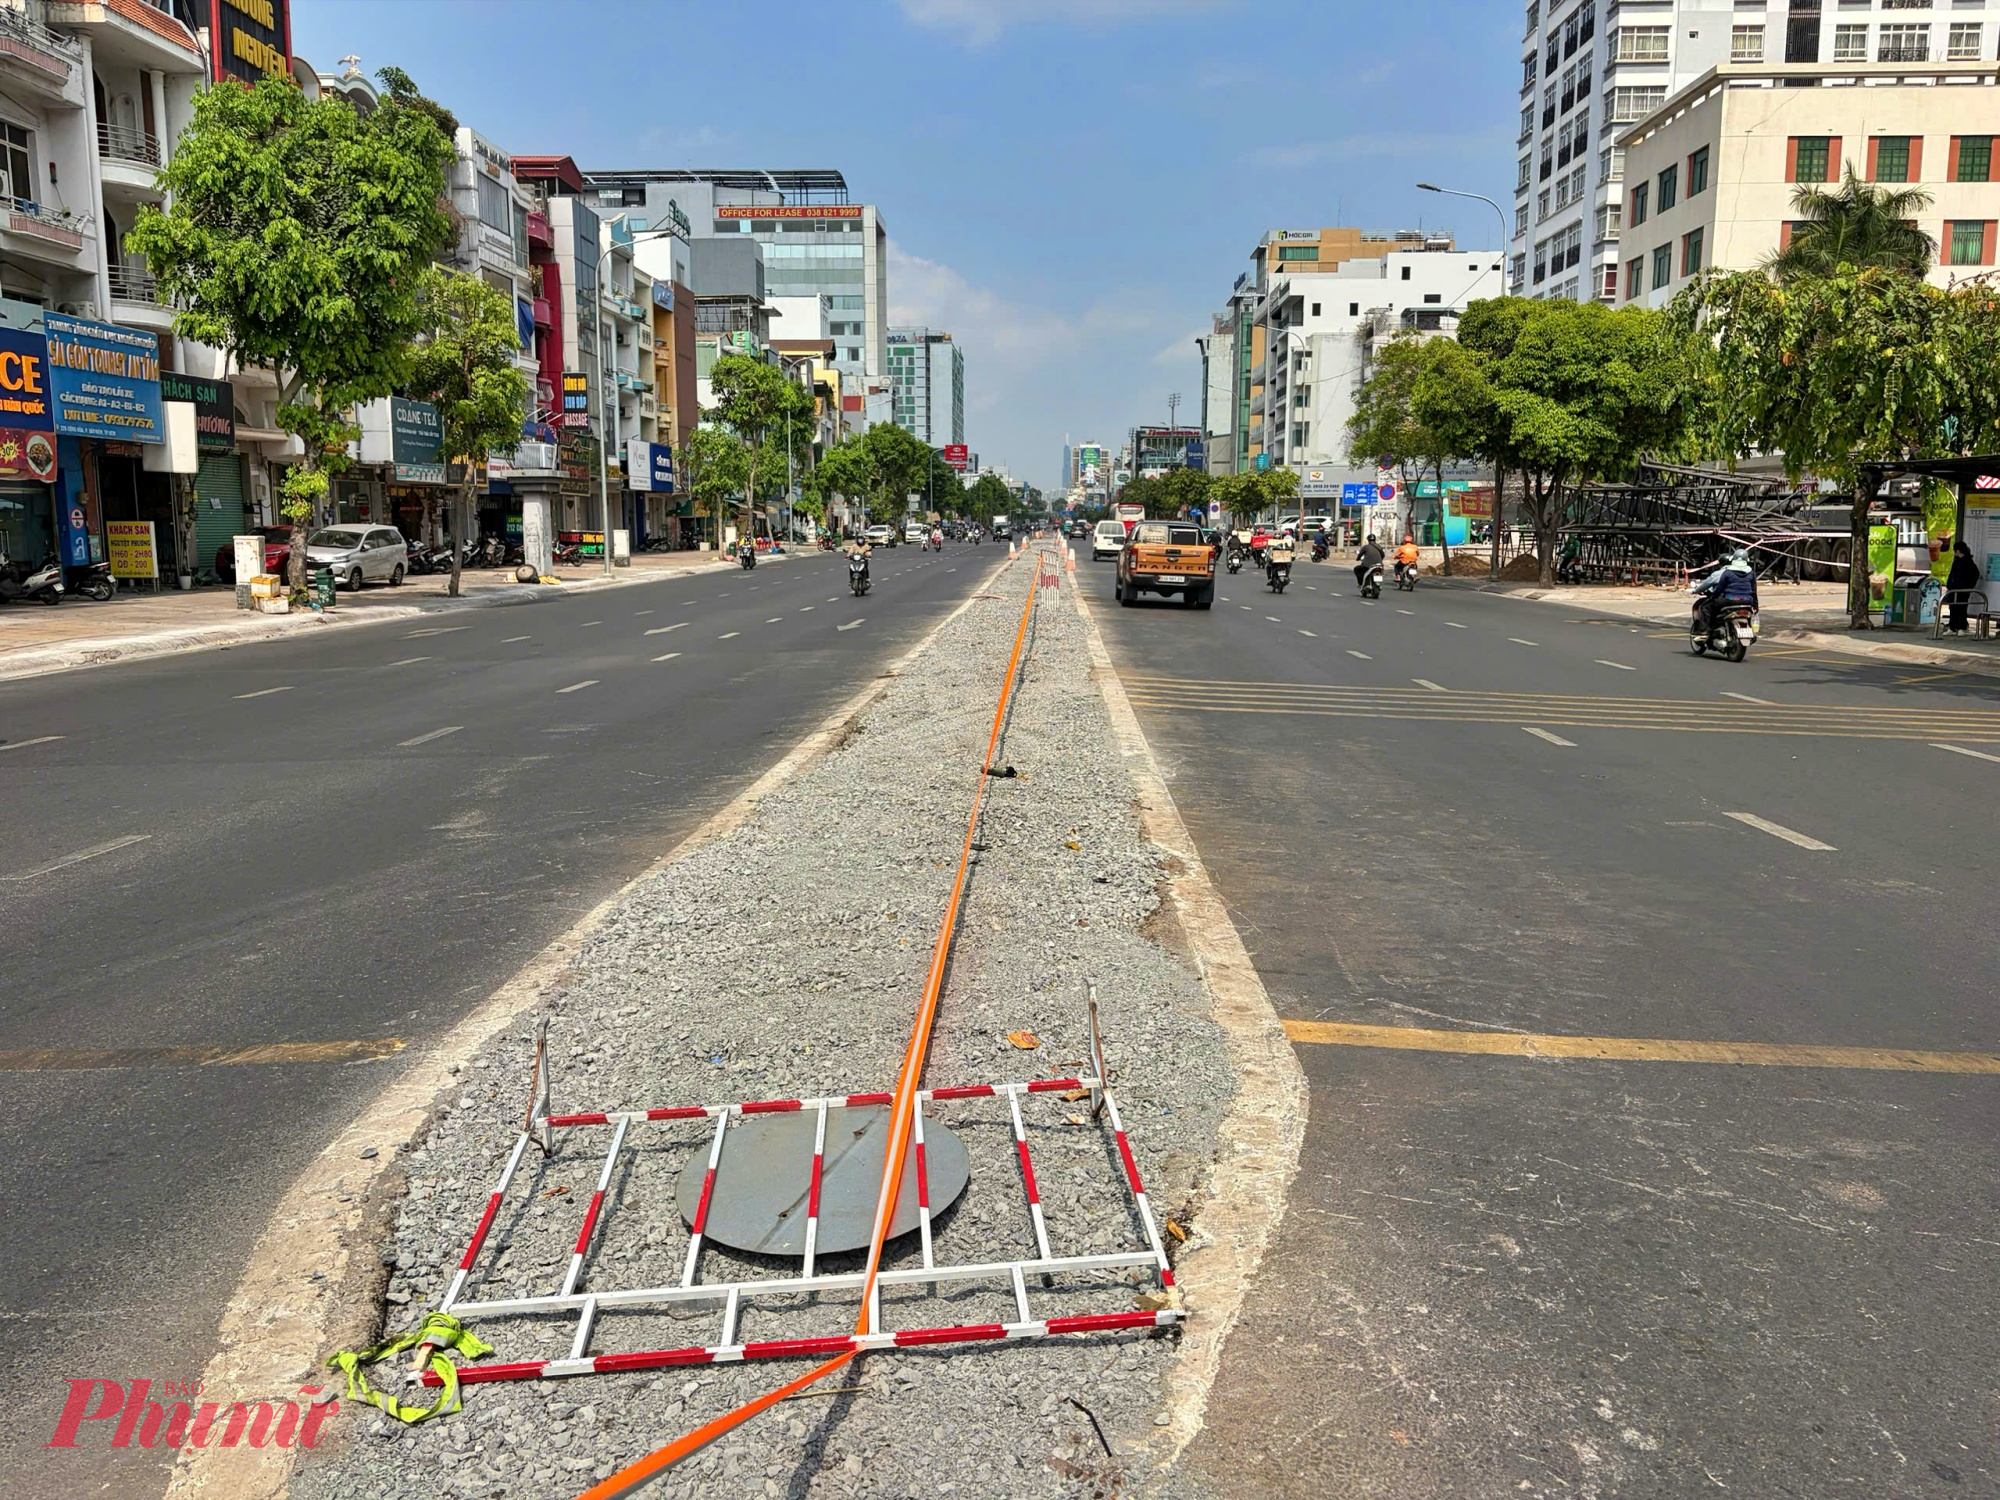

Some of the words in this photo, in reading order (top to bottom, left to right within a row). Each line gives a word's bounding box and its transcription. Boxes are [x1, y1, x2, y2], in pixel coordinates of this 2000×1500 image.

[721, 208, 752, 217] OFFICE
[754, 208, 773, 217] FOR
[774, 208, 802, 217] LEASE
[806, 207, 821, 216] 038
[823, 207, 837, 216] 821
[839, 207, 859, 216] 9999
[48, 334, 66, 367] SÀI
[66, 338, 90, 371] GÒN
[88, 346, 126, 377] TOURIST
[128, 354, 141, 379] AN
[140, 351, 160, 382] TÂM
[0, 351, 43, 394] CE
[196, 385, 217, 405] SẠN
[396, 407, 422, 424] CRANE
[423, 412, 437, 426] TEA
[564, 412, 588, 426] MASSAGE
[135, 525, 151, 537] SẠN
[134, 549, 152, 558] 2H80
[135, 561, 148, 569] 200
